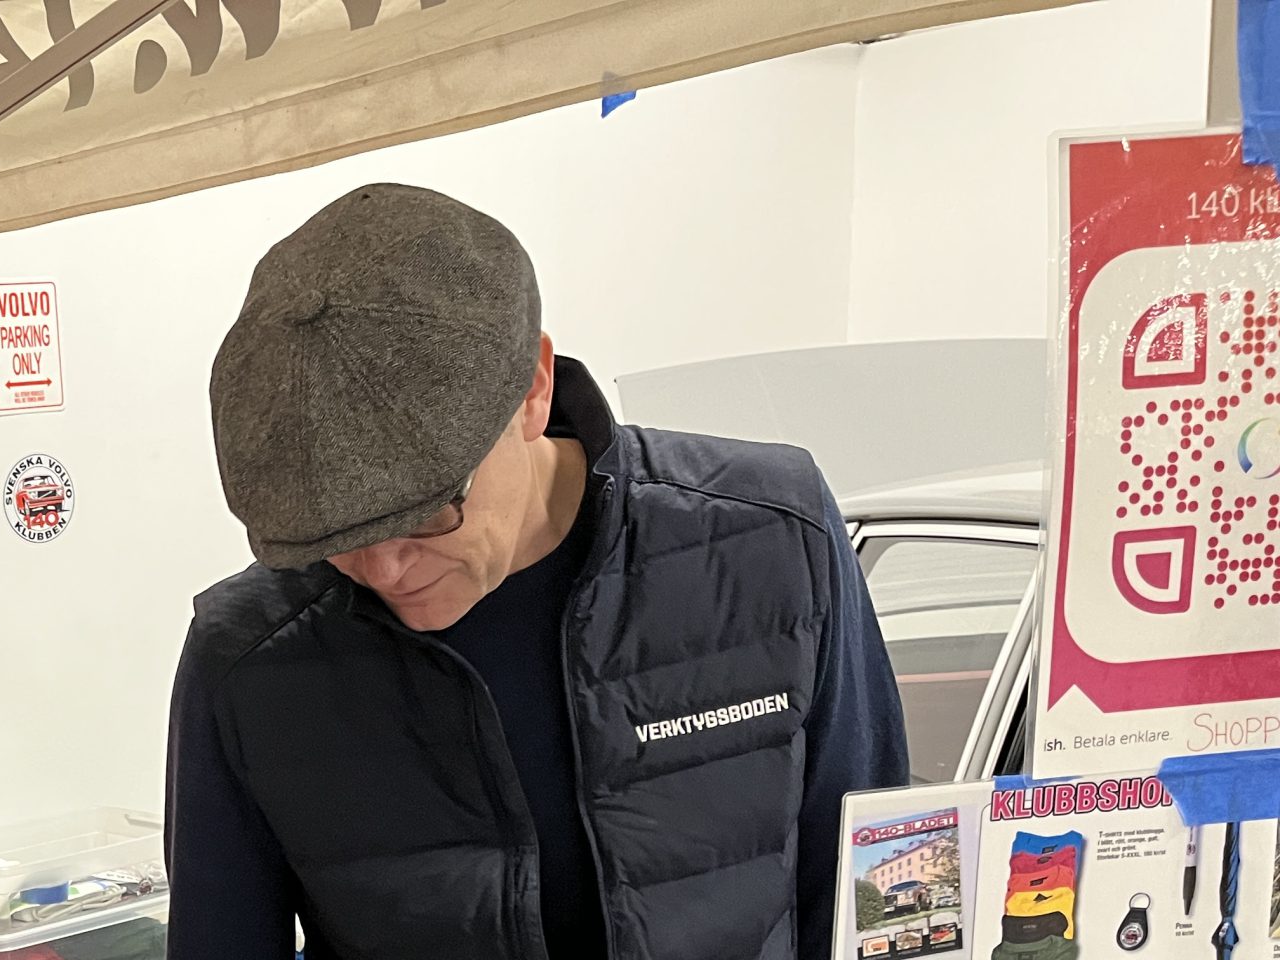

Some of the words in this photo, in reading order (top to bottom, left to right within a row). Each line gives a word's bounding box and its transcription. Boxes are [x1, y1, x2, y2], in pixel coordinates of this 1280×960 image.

[1186, 187, 1240, 219] 140
[0, 325, 50, 349] PARKING
[12, 352, 41, 375] ONLY
[6, 457, 43, 505] SVENSKA
[48, 459, 72, 499] VOLVO
[15, 518, 67, 541] KLUBBEN
[23, 511, 60, 529] 140
[635, 692, 789, 743] VERKTYGSBODEN
[1073, 734, 1116, 749] Betala
[1120, 728, 1174, 745] enklare.
[875, 816, 954, 840] 140-BLADET
